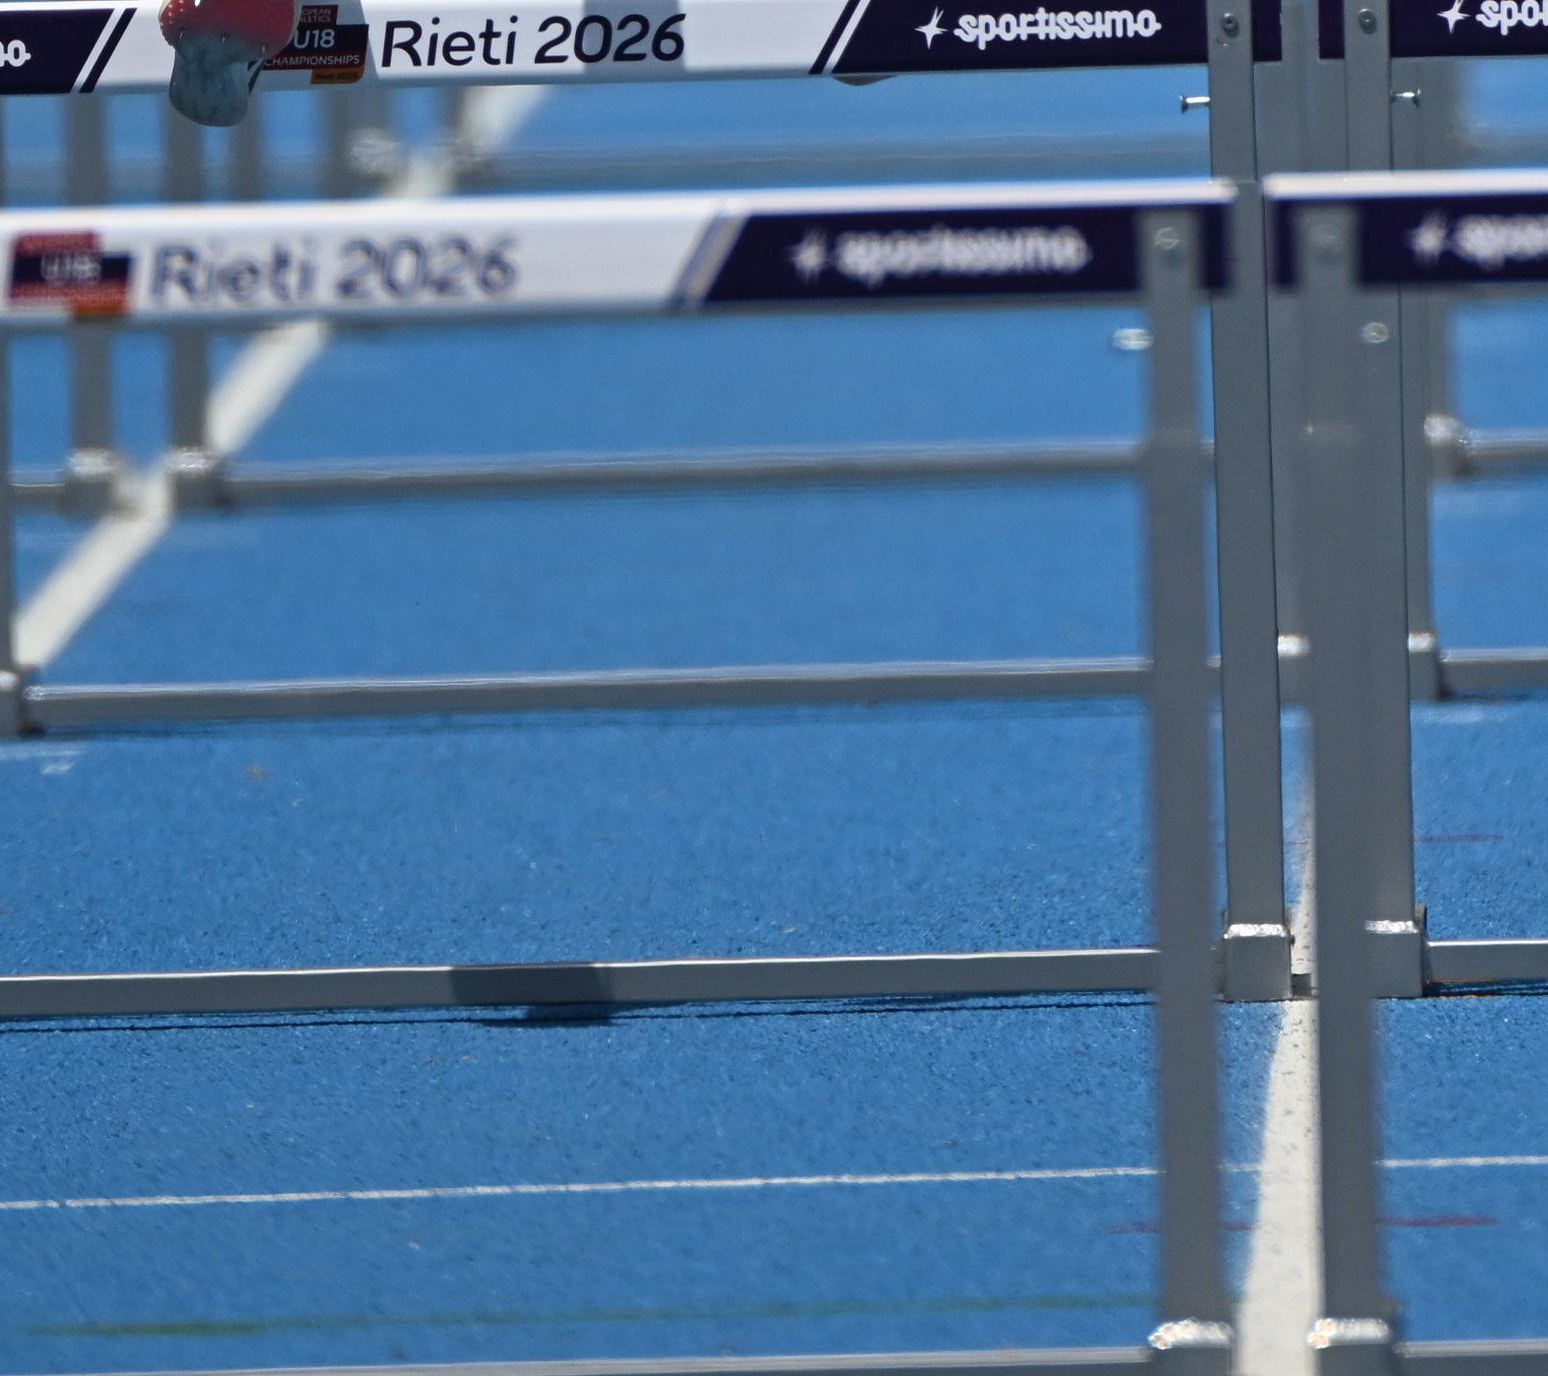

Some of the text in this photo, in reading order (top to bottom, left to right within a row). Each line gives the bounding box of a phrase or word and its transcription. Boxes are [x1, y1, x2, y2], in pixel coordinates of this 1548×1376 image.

[293, 29, 335, 49] U18
[382, 14, 686, 68] Rieti 2026
[953, 6, 1161, 50] sportissimo
[156, 232, 520, 305] Rieti 2026
